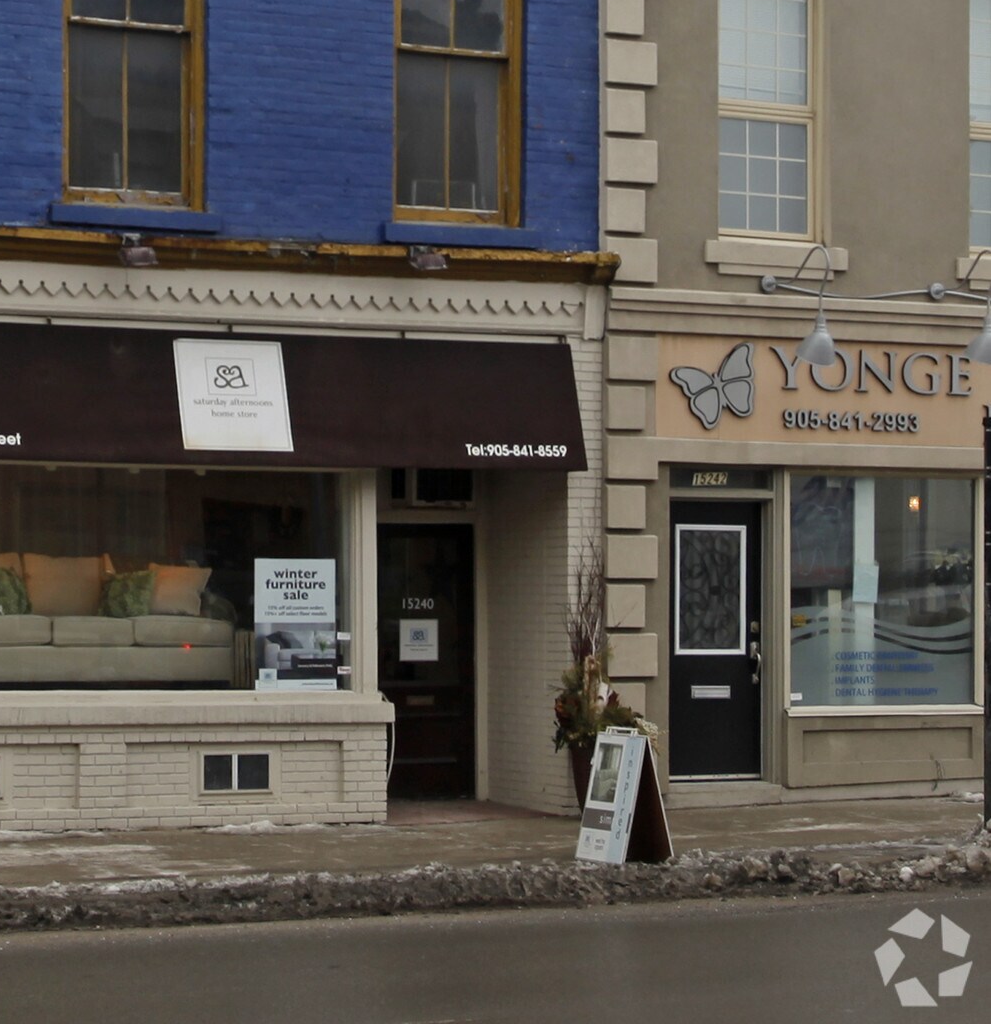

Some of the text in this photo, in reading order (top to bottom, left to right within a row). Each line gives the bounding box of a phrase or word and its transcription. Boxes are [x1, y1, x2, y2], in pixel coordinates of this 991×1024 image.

[769, 346, 972, 397] YONGE
[193, 397, 273, 407] saturday afternoons
[211, 409, 258, 418] home store
[783, 409, 921, 433] 905-841-2993
[465, 443, 568, 457] Tel:905-841-8559
[274, 568, 317, 579] winter
[266, 579, 326, 590] furniture
[283, 590, 309, 600] sale
[402, 598, 434, 609] 15240
[835, 651, 874, 660] COSMETIC
[835, 663, 864, 672] FAMILY
[835, 676, 874, 684] IMPLANTS
[835, 688, 866, 697] DENTAL
